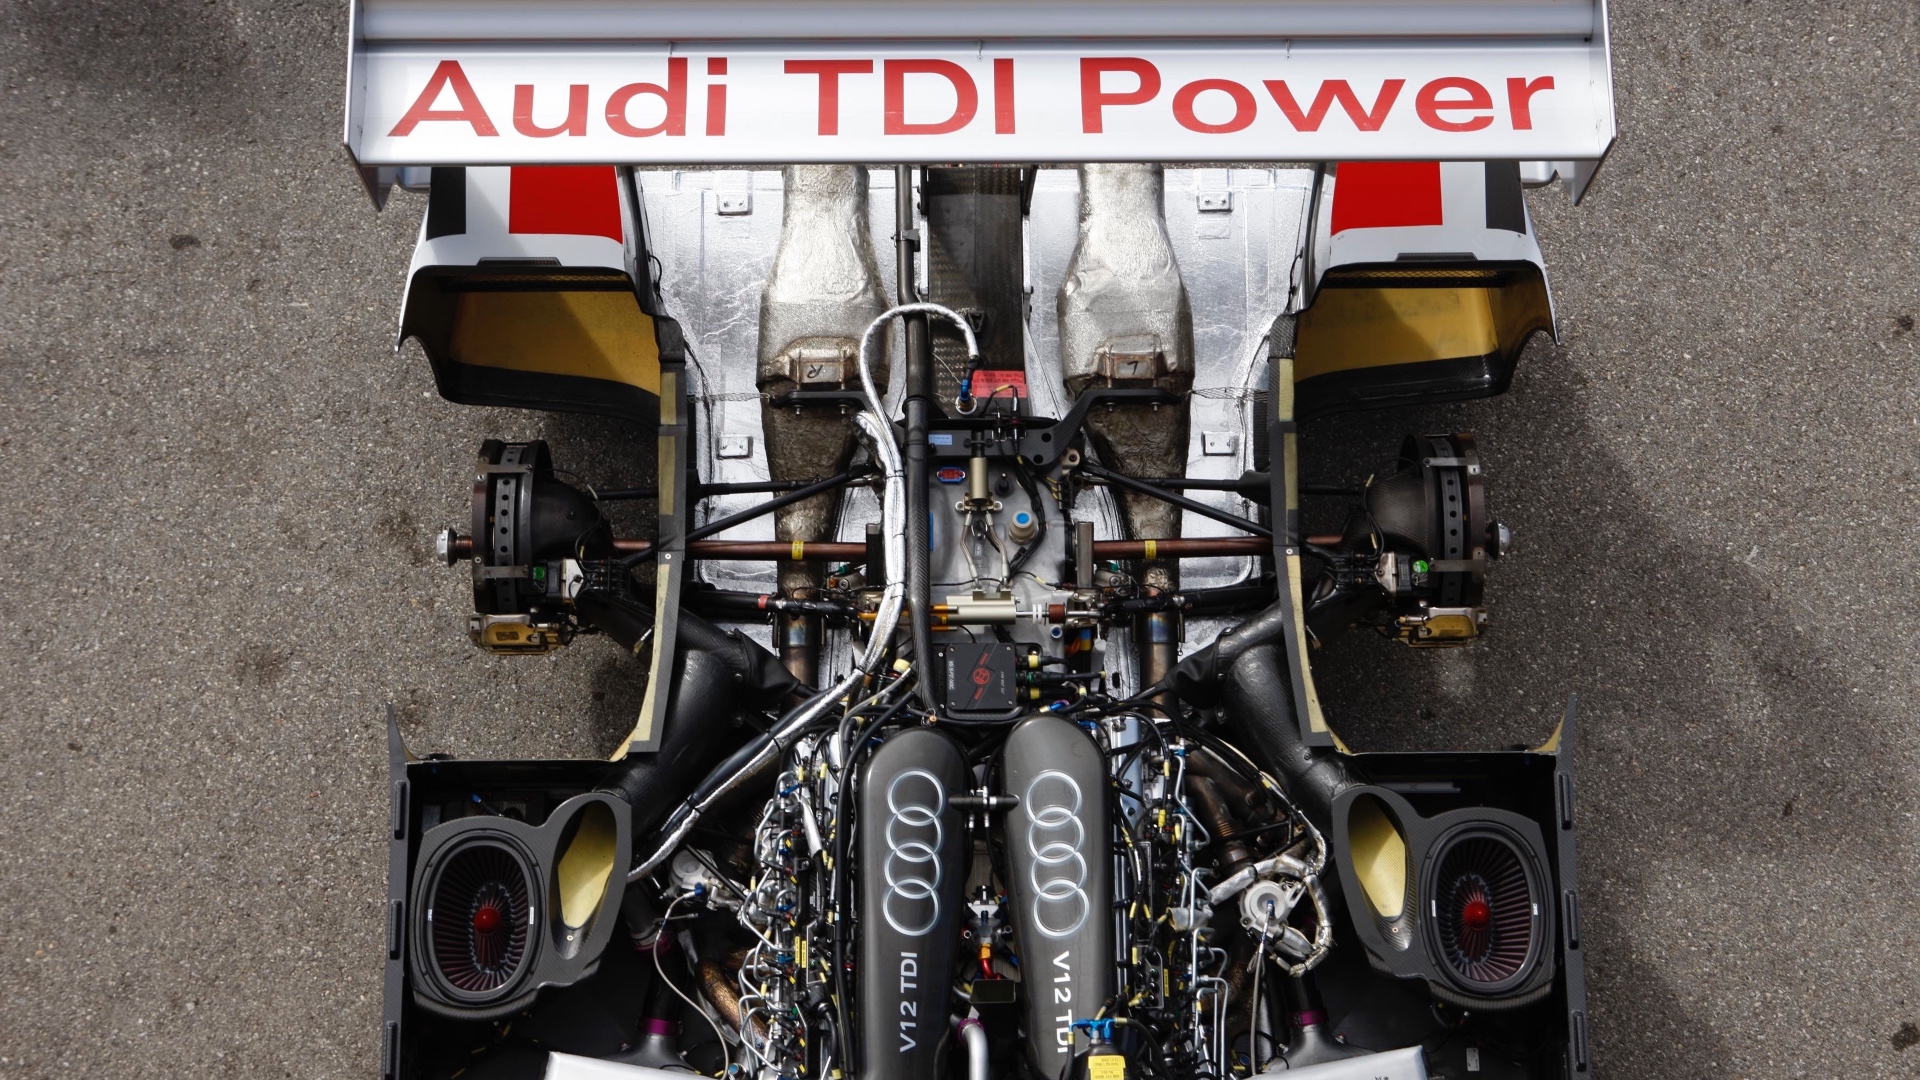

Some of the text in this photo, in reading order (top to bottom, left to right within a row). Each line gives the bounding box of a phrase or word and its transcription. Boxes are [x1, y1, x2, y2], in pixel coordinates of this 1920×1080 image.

[387, 56, 1554, 138] Audi TDI Power
[899, 951, 918, 1053] V12 TDI
[1053, 950, 1074, 1054] V12 TDI
